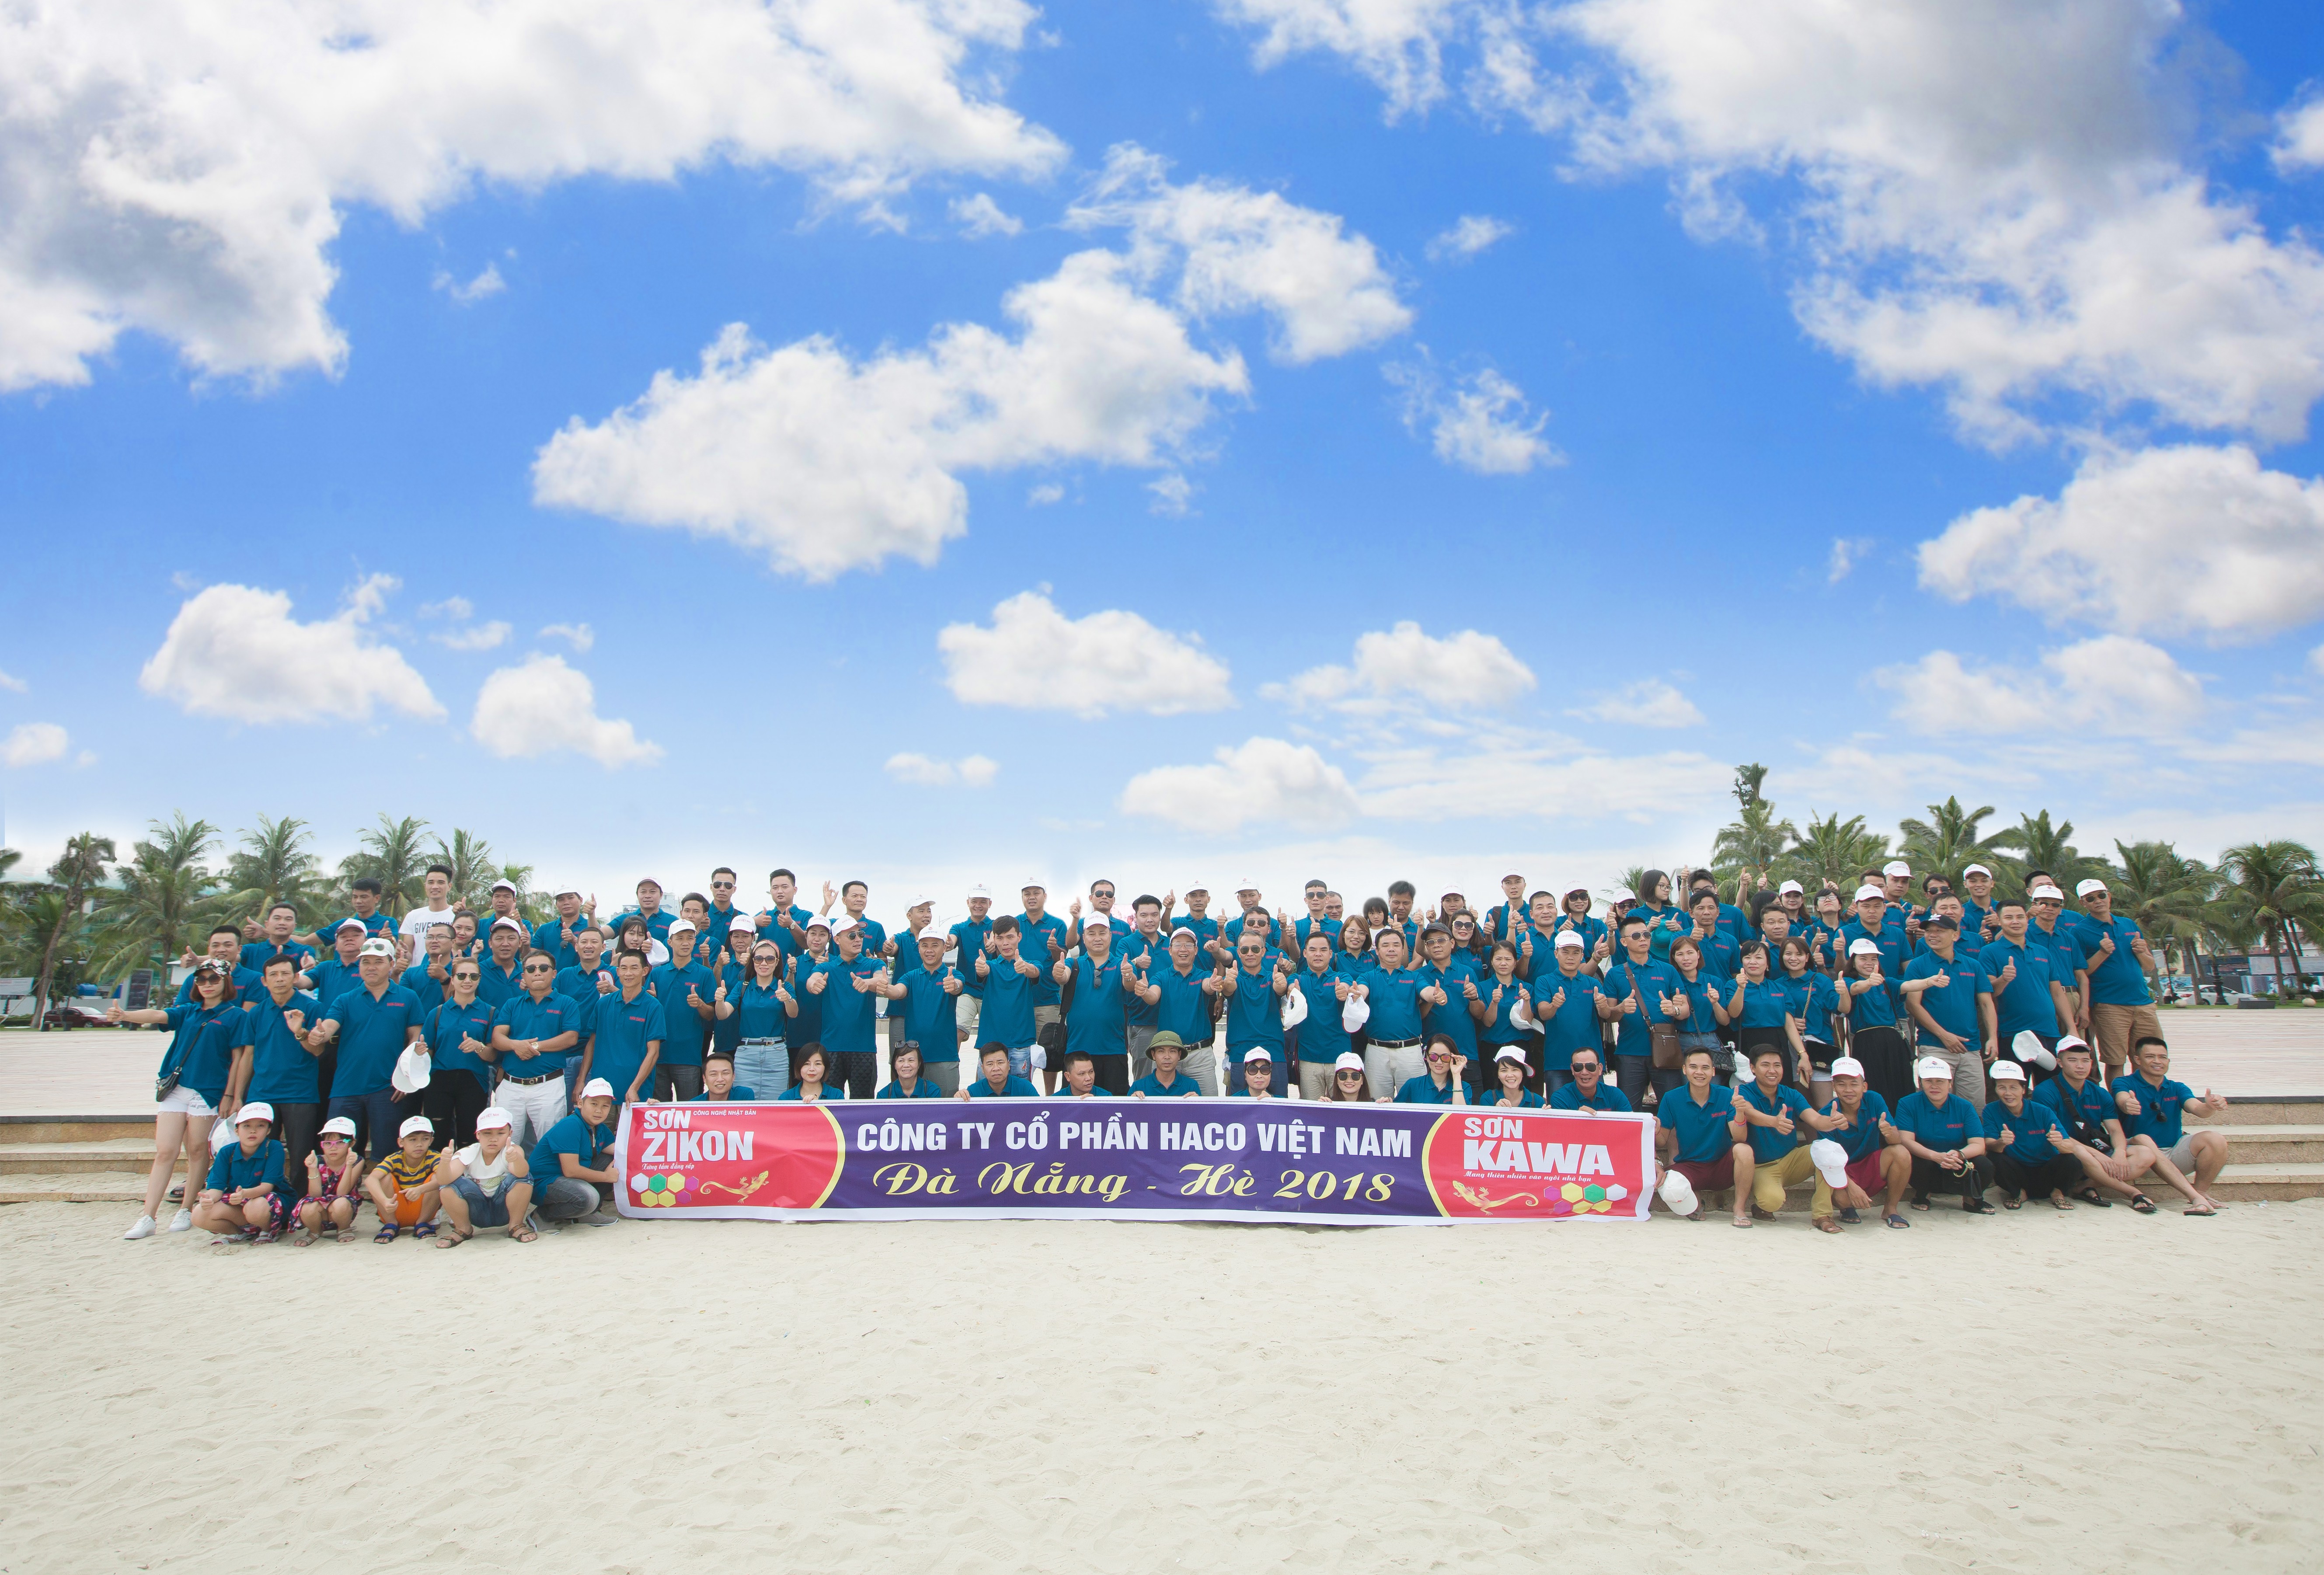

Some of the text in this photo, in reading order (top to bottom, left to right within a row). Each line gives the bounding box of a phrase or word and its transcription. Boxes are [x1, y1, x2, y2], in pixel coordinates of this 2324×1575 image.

[643, 1109, 691, 1129] SƠN
[857, 1111, 1411, 1159] CÔNG TY CỔ PHẦN HACO VIỆT NAM
[1464, 1116, 1523, 1139] SƠN
[641, 1131, 754, 1163] ZIKON
[1463, 1139, 1615, 1176] KAWA
[873, 1162, 959, 1195] Đà
[978, 1161, 1131, 1202] Nẵng
[1179, 1163, 1257, 1196] Hè
[1273, 1169, 1396, 1202] 2018
